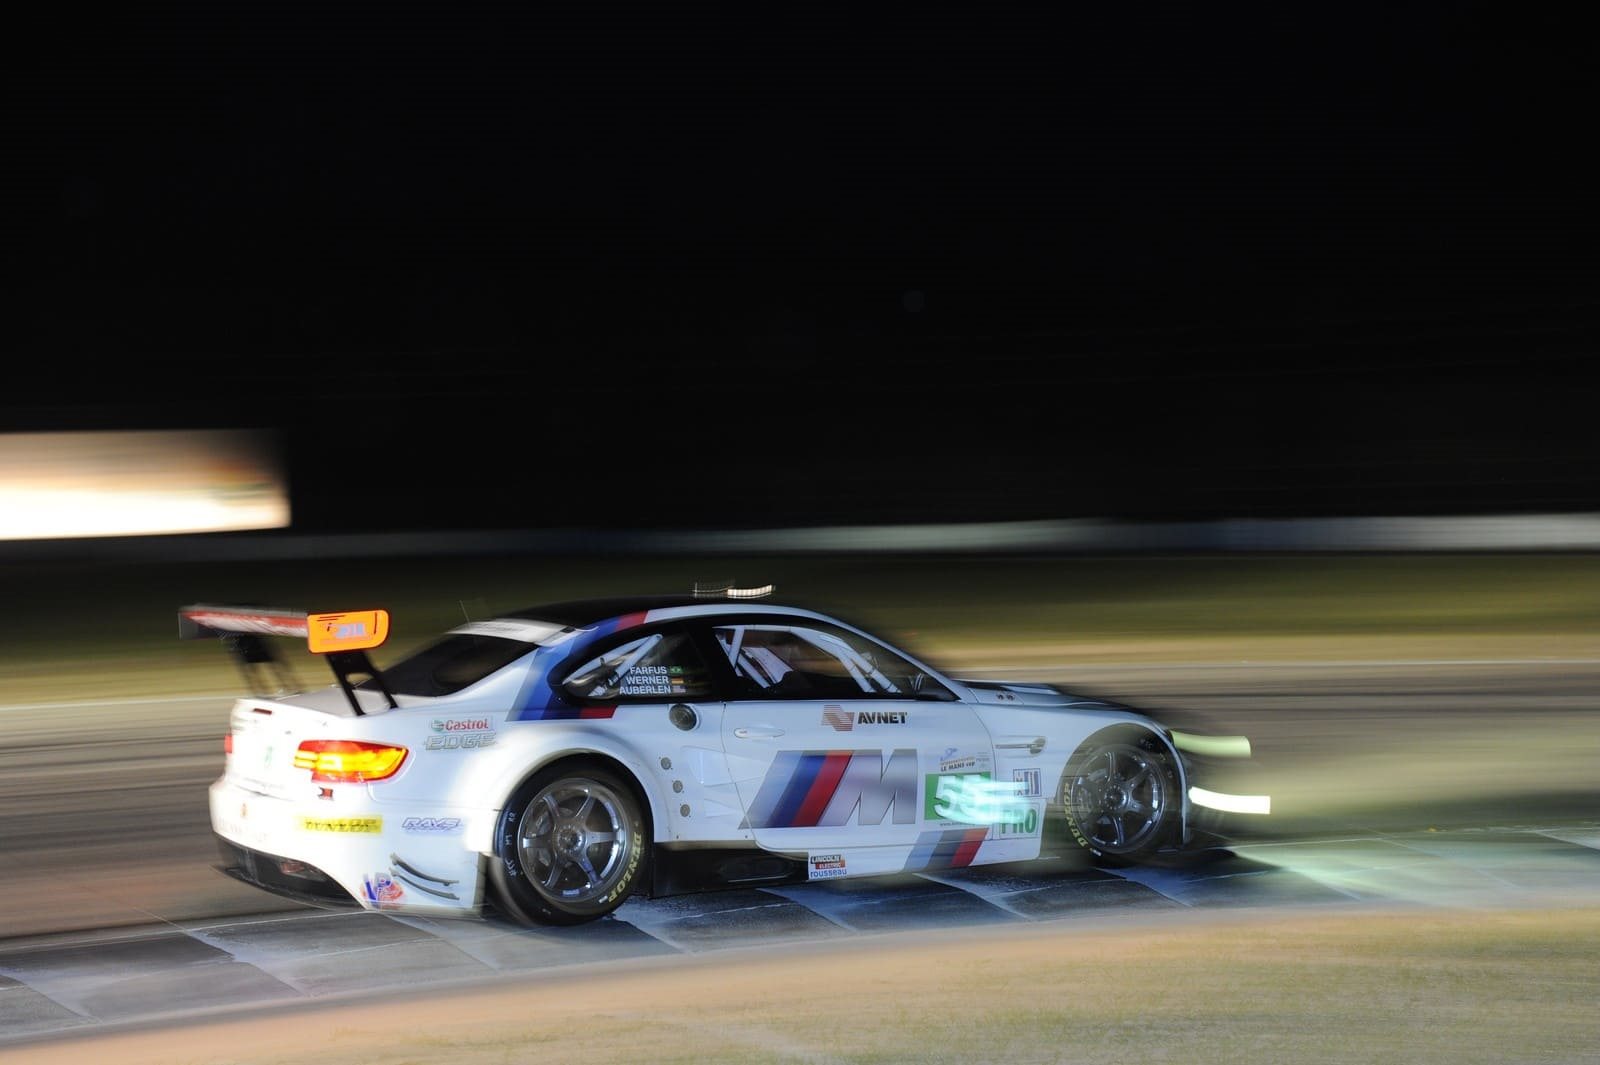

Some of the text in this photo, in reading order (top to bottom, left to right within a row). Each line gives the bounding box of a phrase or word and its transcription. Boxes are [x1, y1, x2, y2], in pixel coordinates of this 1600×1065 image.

[630, 666, 667, 675] FARFUS
[625, 675, 669, 685] WERNER
[619, 685, 671, 695] AUBERLEN
[857, 711, 907, 725] AVNET
[446, 719, 489, 731] Castrol
[424, 733, 497, 750] EDGE
[608, 831, 642, 903] DUNLOP
[810, 869, 848, 878] rousseau
